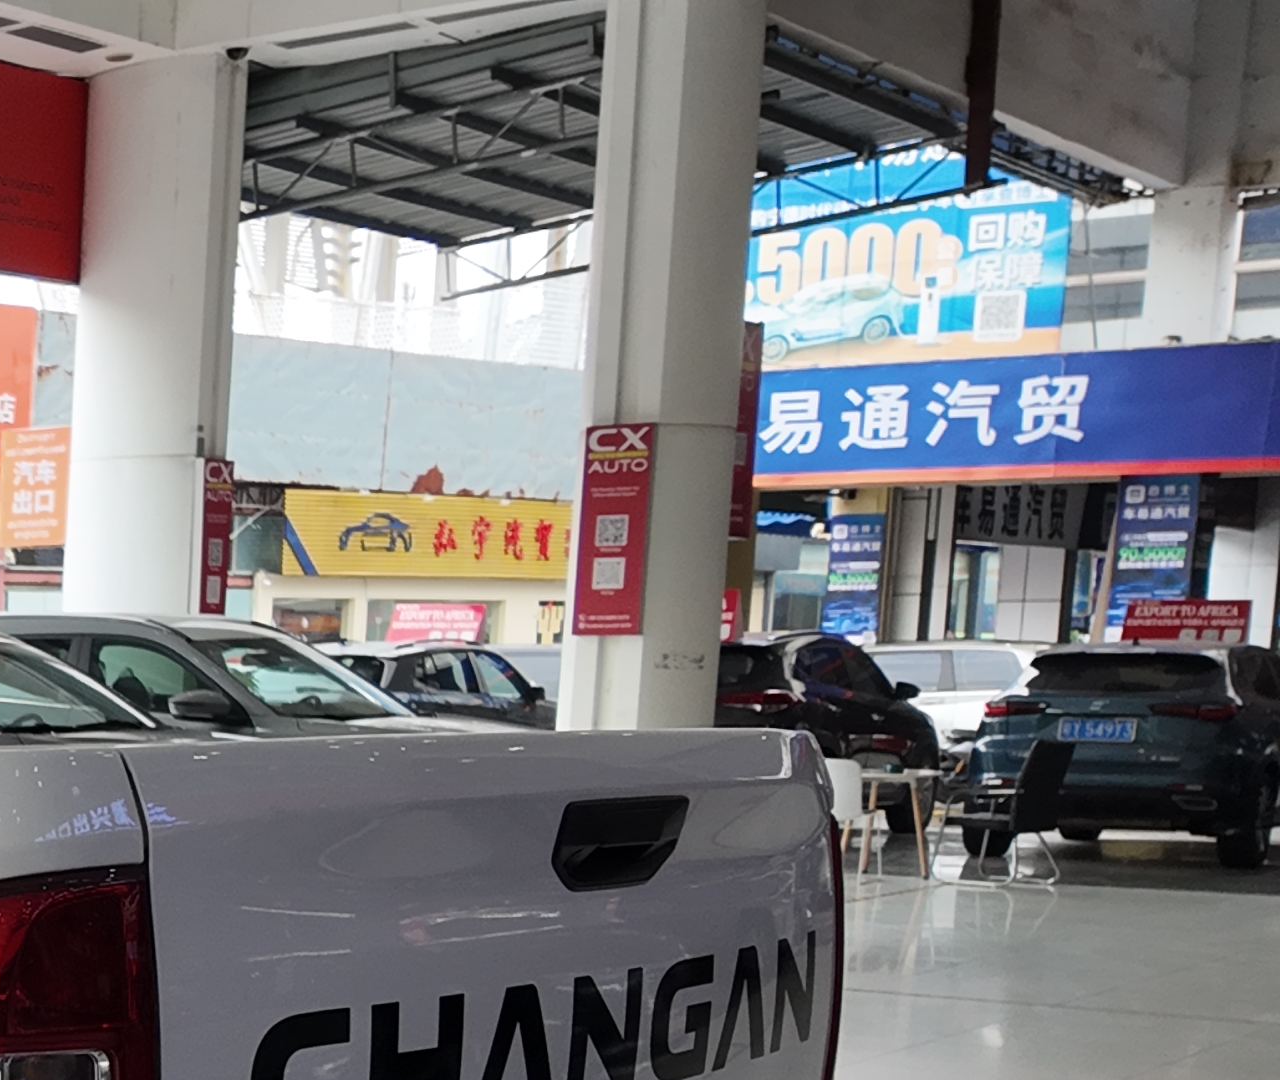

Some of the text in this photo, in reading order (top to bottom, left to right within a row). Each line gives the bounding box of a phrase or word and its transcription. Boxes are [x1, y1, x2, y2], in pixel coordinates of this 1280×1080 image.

[967, 210, 1047, 252] 回购
[966, 251, 1044, 290] 保障
[759, 375, 1090, 455] 易通汽贸
[589, 427, 650, 452] CX
[13, 459, 57, 486] 汽车
[205, 461, 233, 484] CX
[588, 458, 648, 474] AUTO
[12, 489, 55, 515] 出口
[206, 489, 233, 503] AUTO
[1134, 604, 1239, 617] EXPORT TO AFRICA
